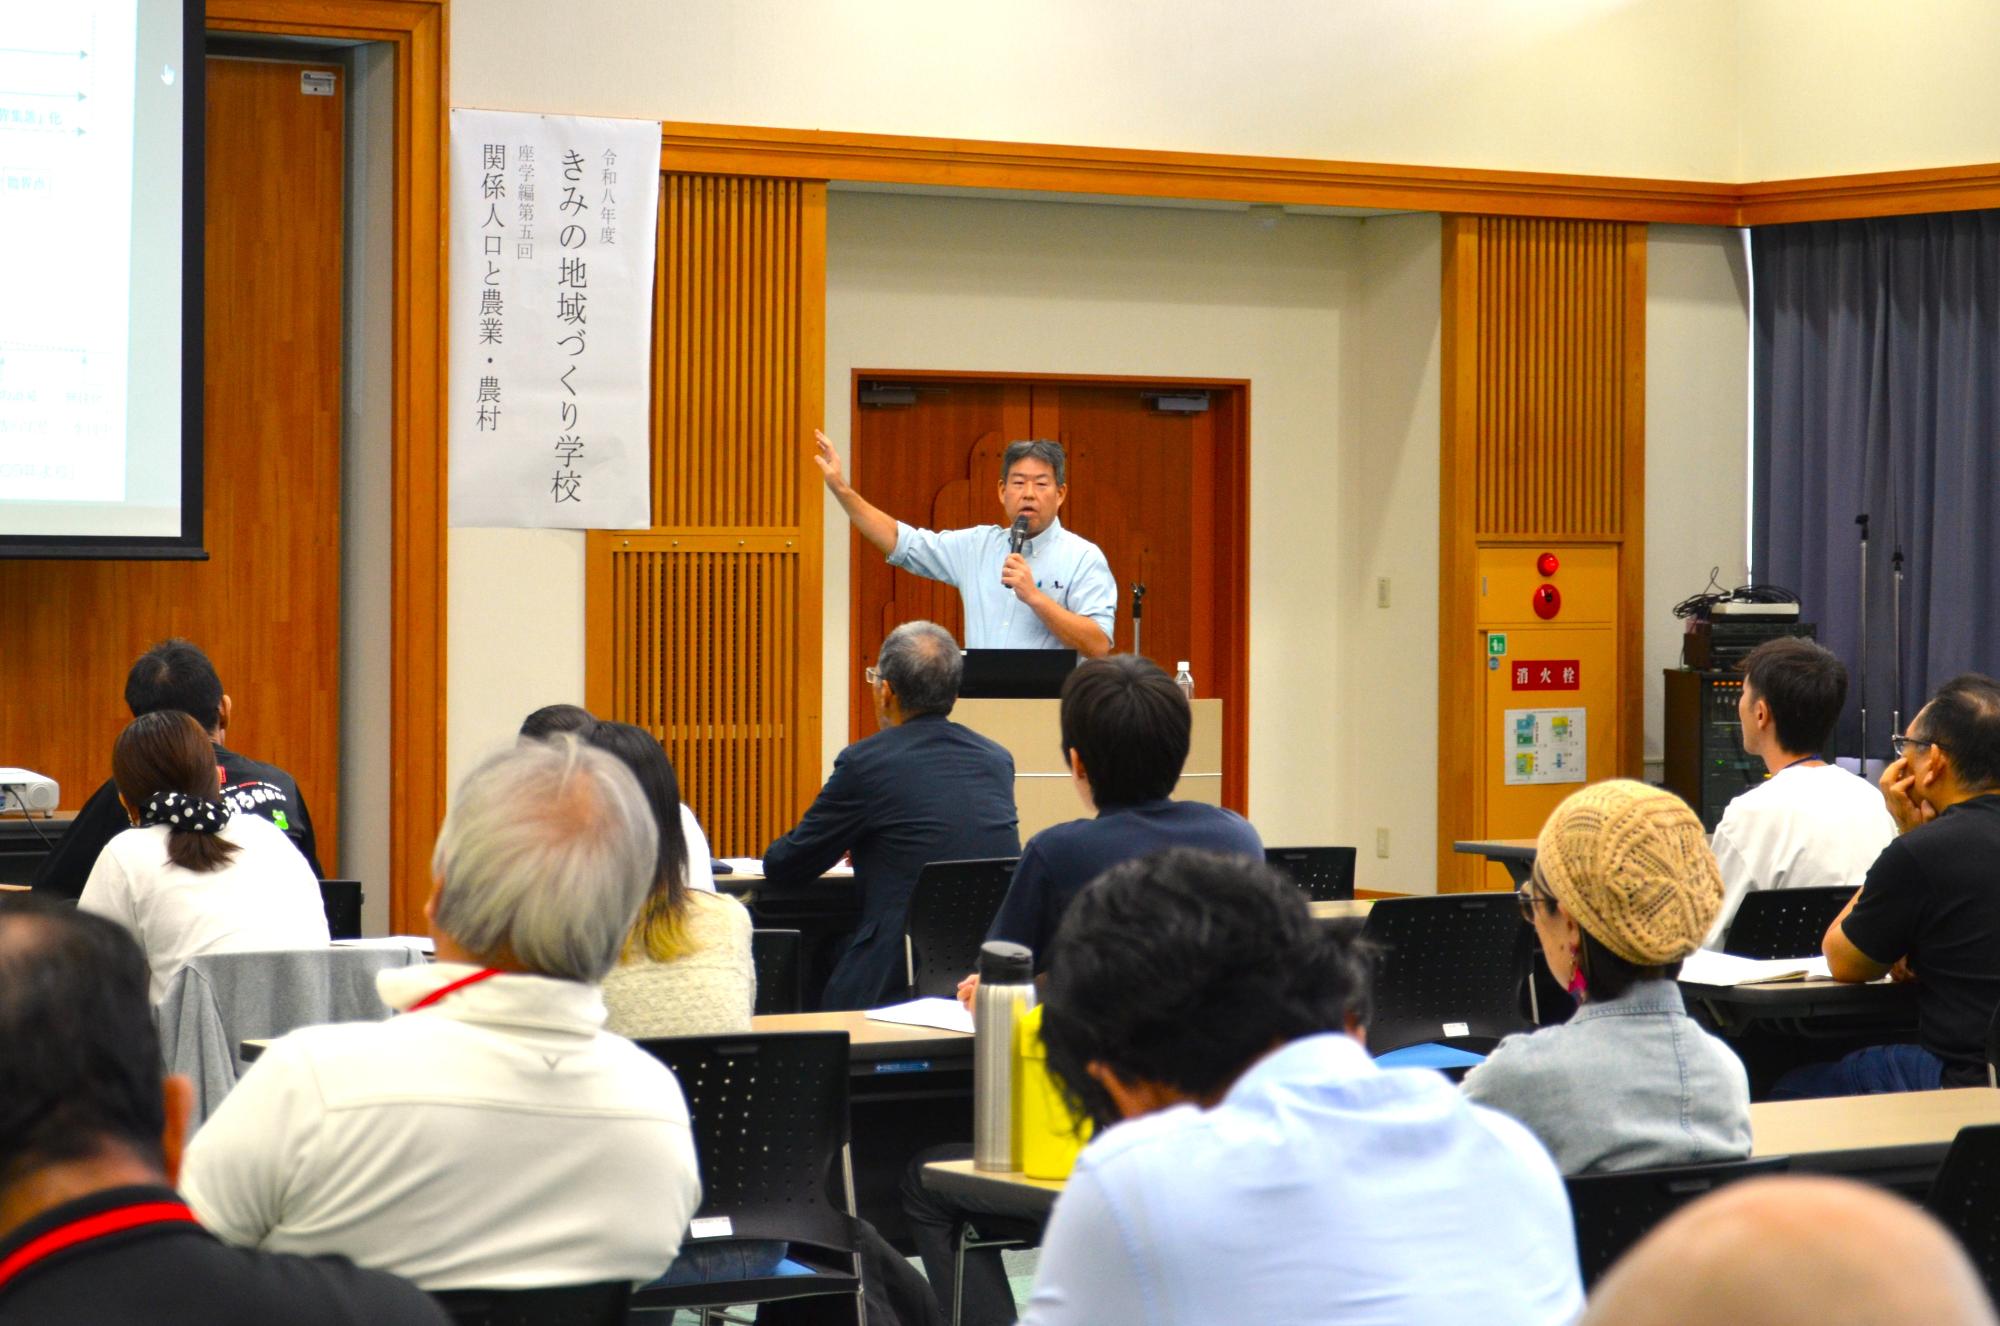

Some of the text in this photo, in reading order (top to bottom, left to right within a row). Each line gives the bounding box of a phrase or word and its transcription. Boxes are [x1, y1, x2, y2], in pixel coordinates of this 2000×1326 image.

[517, 144, 535, 261] 座学編第五回
[600, 148, 617, 245] 令和八年度
[476, 143, 506, 432] 関係人口と農業・農村
[551, 149, 588, 504] きみの地域づくり学校
[1516, 667, 1575, 684] 消火栓
